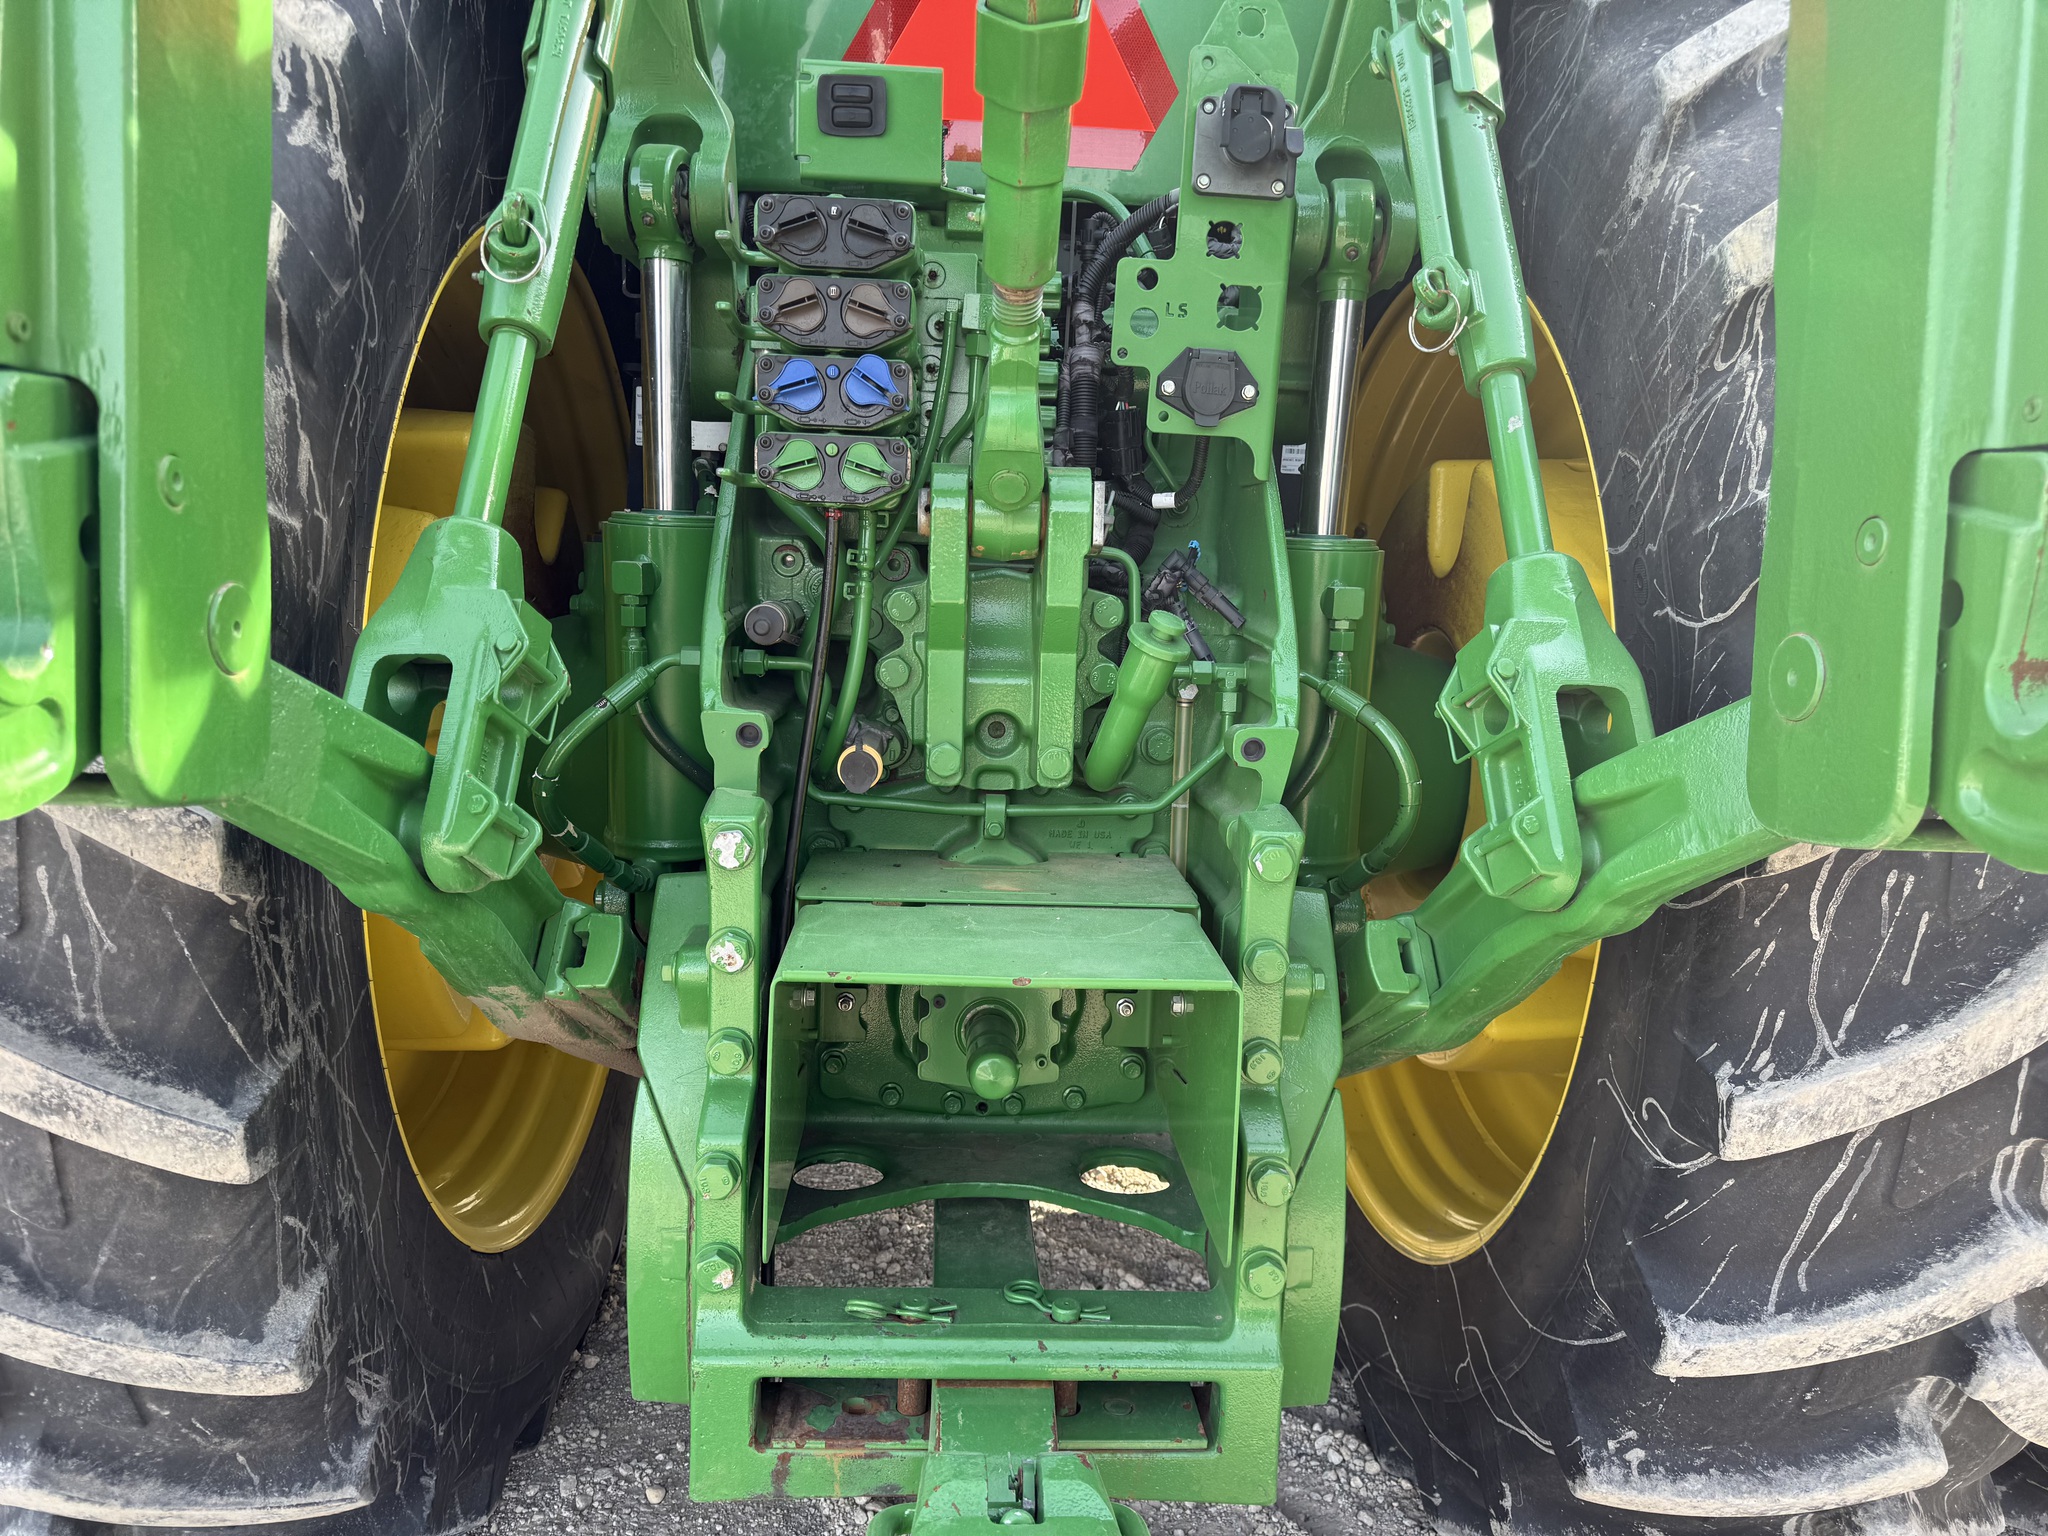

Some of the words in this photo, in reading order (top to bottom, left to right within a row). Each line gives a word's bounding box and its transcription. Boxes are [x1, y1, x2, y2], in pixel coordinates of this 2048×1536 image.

[1396, 48, 1406, 71] USA
[1193, 381, 1228, 396] Pollak
[1048, 829, 1073, 839] MADE
[1078, 830, 1089, 839] IN
[1094, 831, 1112, 840] USA
